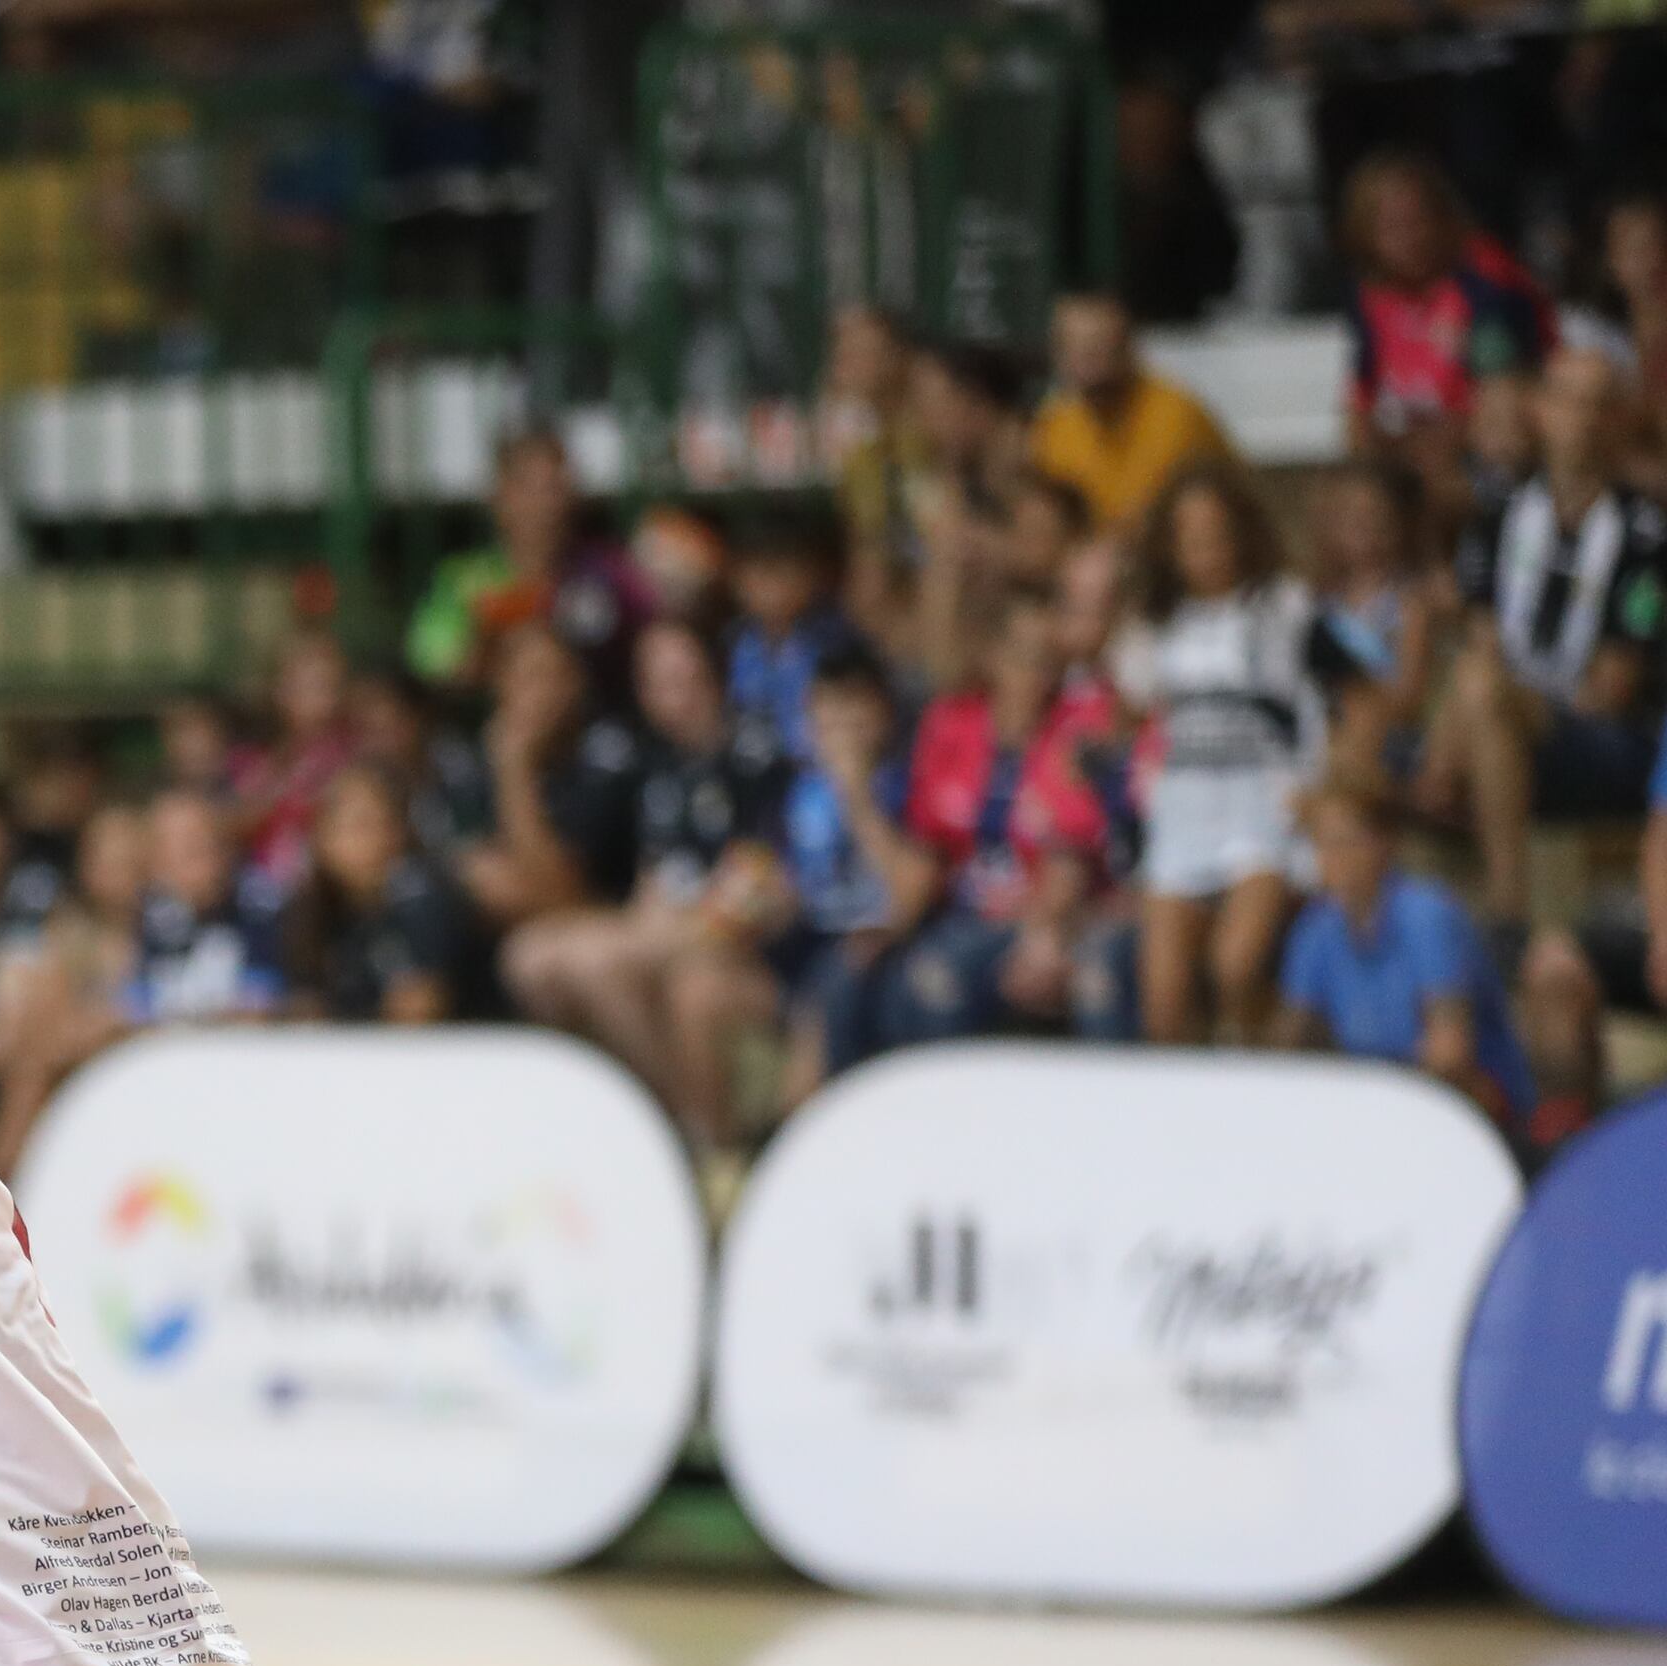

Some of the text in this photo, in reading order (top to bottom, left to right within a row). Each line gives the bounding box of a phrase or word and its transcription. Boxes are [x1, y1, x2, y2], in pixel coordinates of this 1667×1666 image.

[7, 1516, 40, 1532] Kåre
[41, 1535, 86, 1550] Steinar
[35, 1555, 73, 1572] Alfred
[73, 1551, 116, 1569] Berdal
[117, 1543, 164, 1564] Solen
[21, 1577, 69, 1597] Birger
[72, 1575, 127, 1589] Andresen
[144, 1565, 173, 1582] Jon
[60, 1597, 91, 1613] Olav
[93, 1596, 131, 1613] Hagen
[132, 1584, 185, 1608] Berdal
[94, 1617, 134, 1633] Dallas
[106, 1637, 155, 1653] Kristine
[158, 1633, 179, 1649] og
